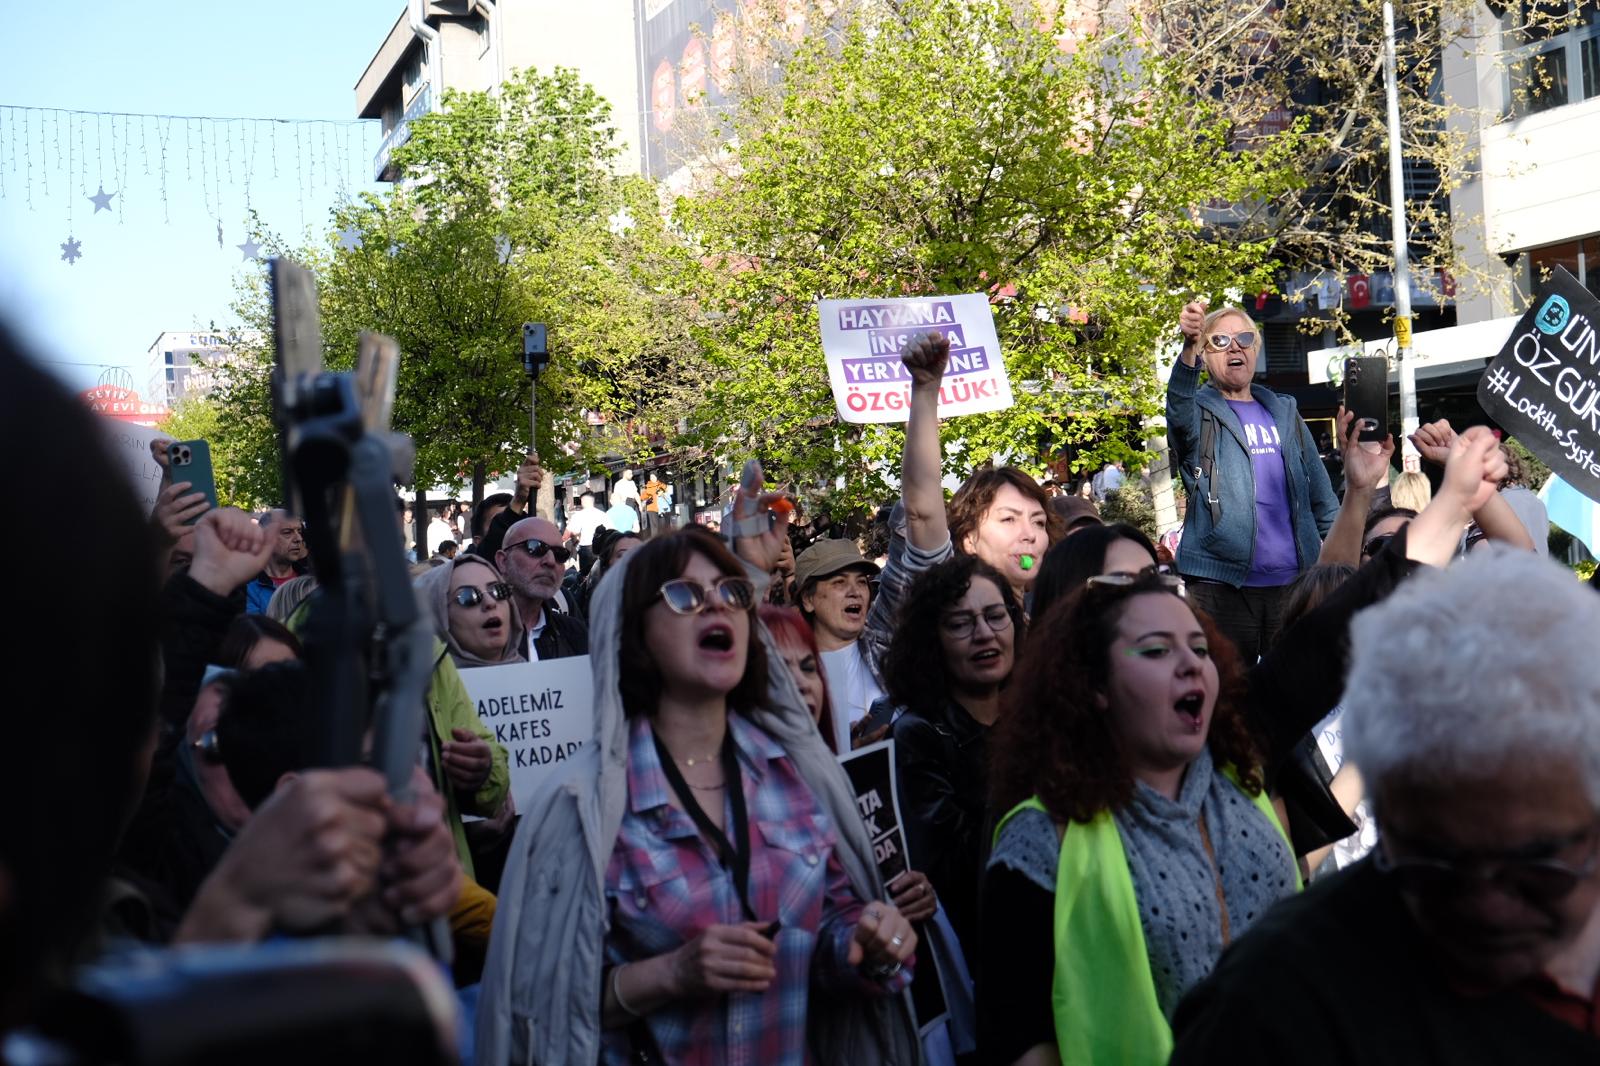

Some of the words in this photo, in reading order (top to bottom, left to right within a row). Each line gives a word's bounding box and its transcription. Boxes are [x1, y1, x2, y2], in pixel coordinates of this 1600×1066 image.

[840, 306, 953, 329] HAYVANA
[870, 331, 963, 354] İNSA
[1534, 294, 1600, 376] DÜN
[846, 352, 984, 381] YERYNE
[1513, 327, 1600, 434] ÖZGÜR
[846, 377, 998, 412] ÖZGLÜK!
[1487, 366, 1600, 478] #LocktheSyste
[477, 687, 564, 718] ADELEMİZ
[495, 719, 551, 743] KAFES
[515, 741, 582, 768] KADA
